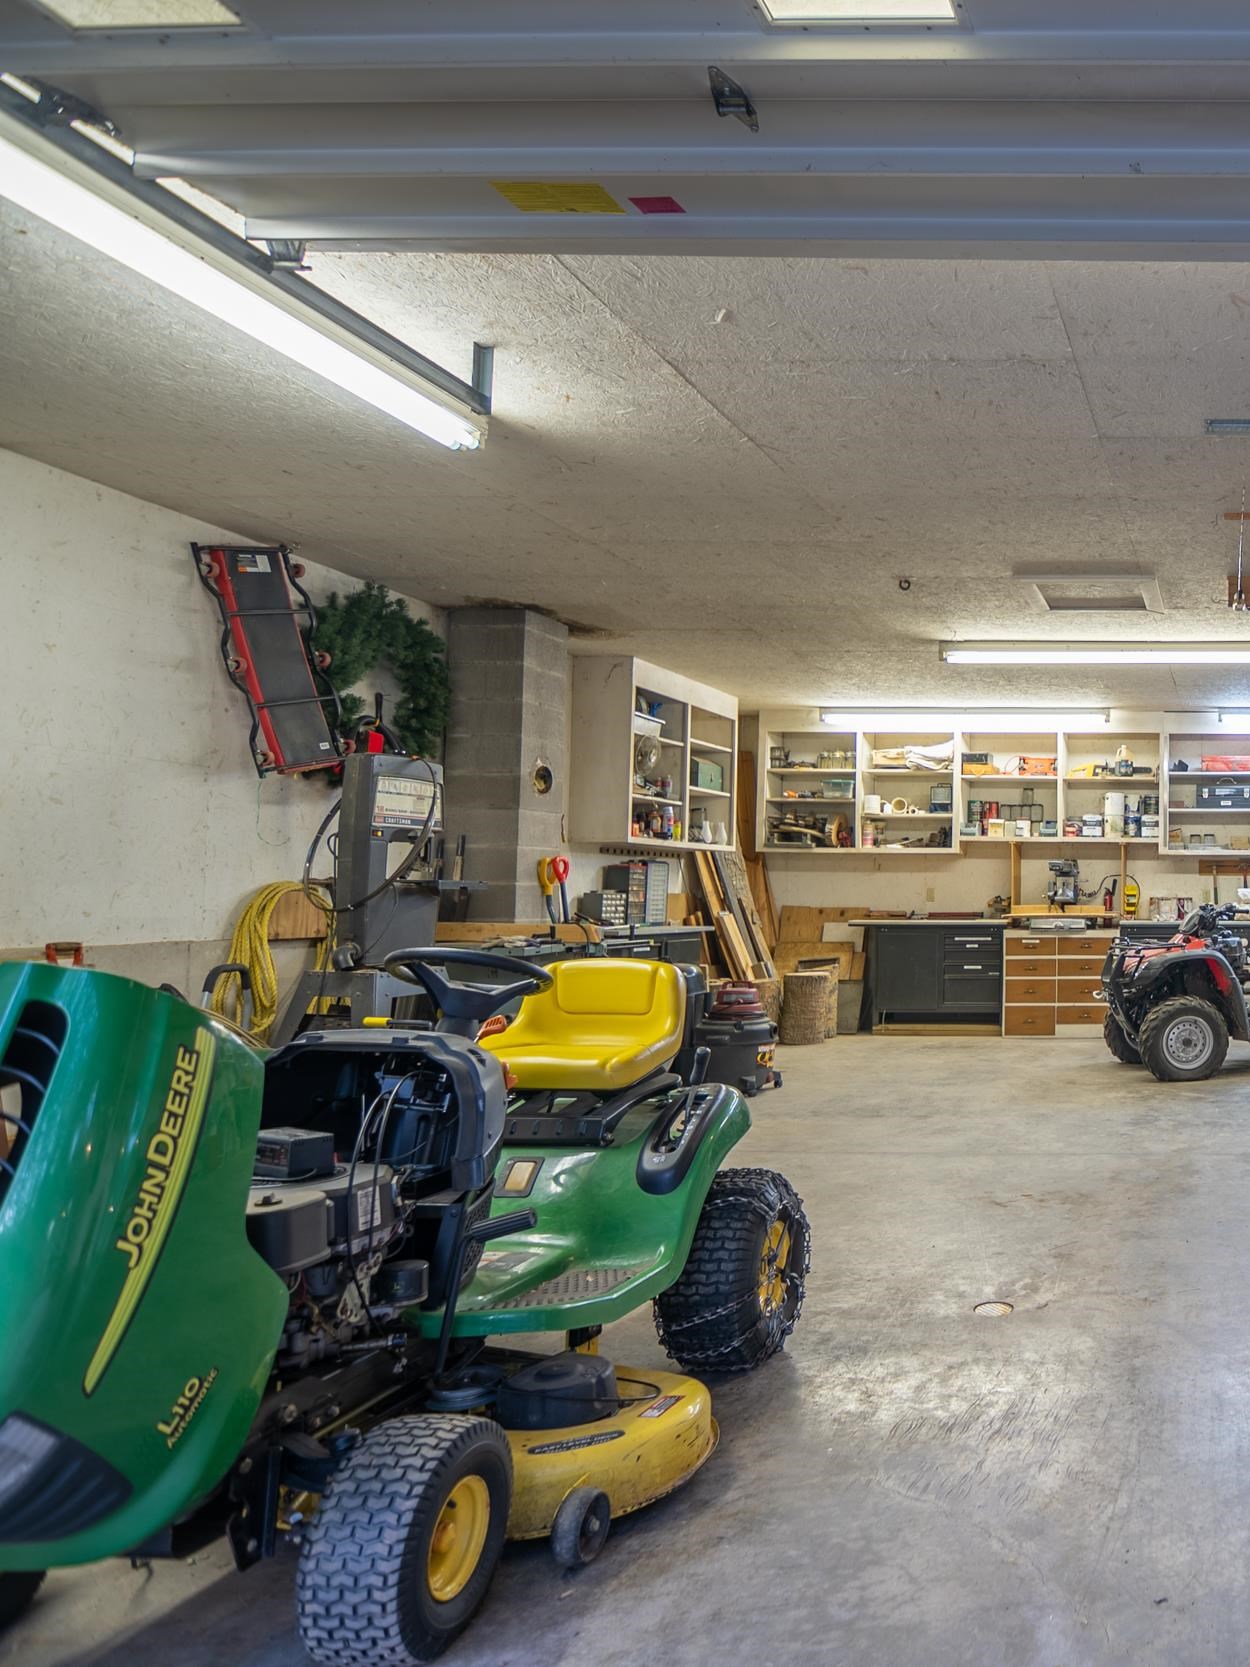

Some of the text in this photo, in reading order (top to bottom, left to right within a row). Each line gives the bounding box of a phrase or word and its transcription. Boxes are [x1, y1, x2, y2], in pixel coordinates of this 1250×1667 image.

[385, 817, 411, 825] CRAFTSMAN
[115, 1045, 199, 1270] JOHN DEERE
[157, 1376, 201, 1435] L110
[166, 1367, 218, 1450] Automatic
